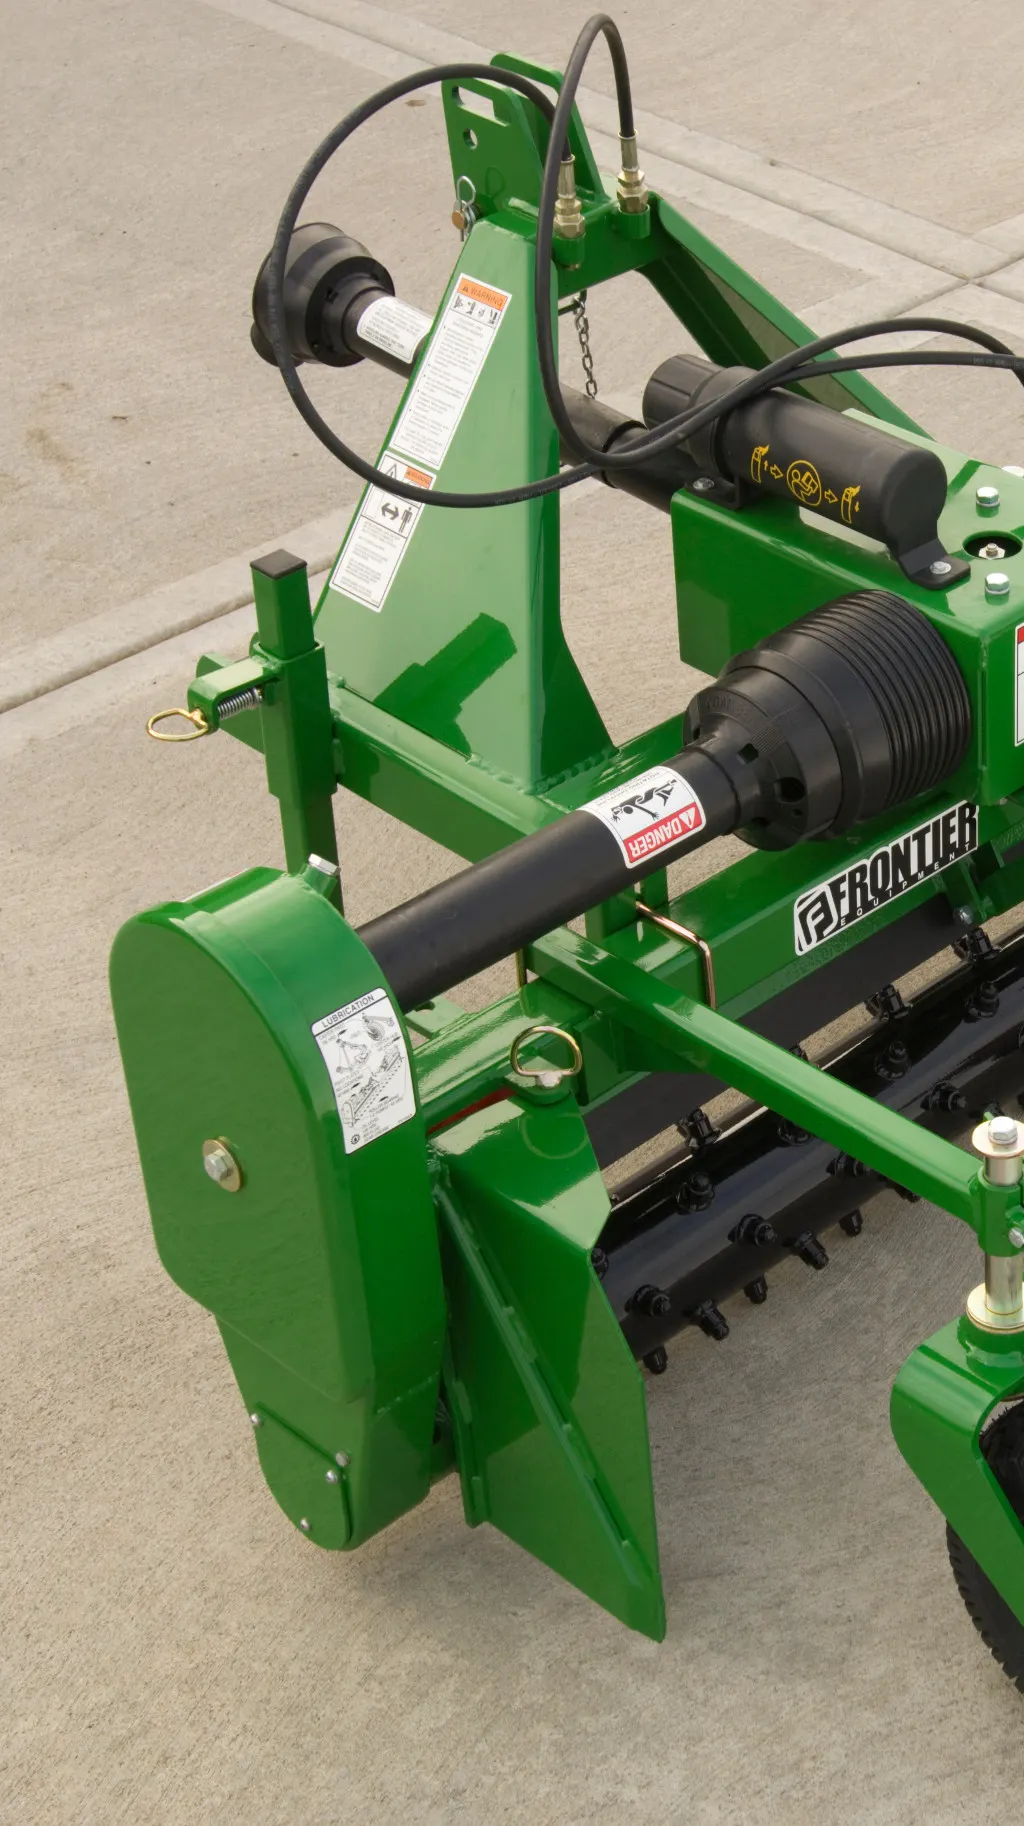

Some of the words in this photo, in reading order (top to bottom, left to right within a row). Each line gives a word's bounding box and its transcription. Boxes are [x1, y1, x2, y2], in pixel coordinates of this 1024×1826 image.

[470, 287, 504, 307] WARNING
[628, 816, 683, 858] DANGER
[827, 801, 977, 922] FRONTIER
[841, 844, 971, 927] EQUIPMENT
[321, 994, 375, 1028] LUBRICATION
